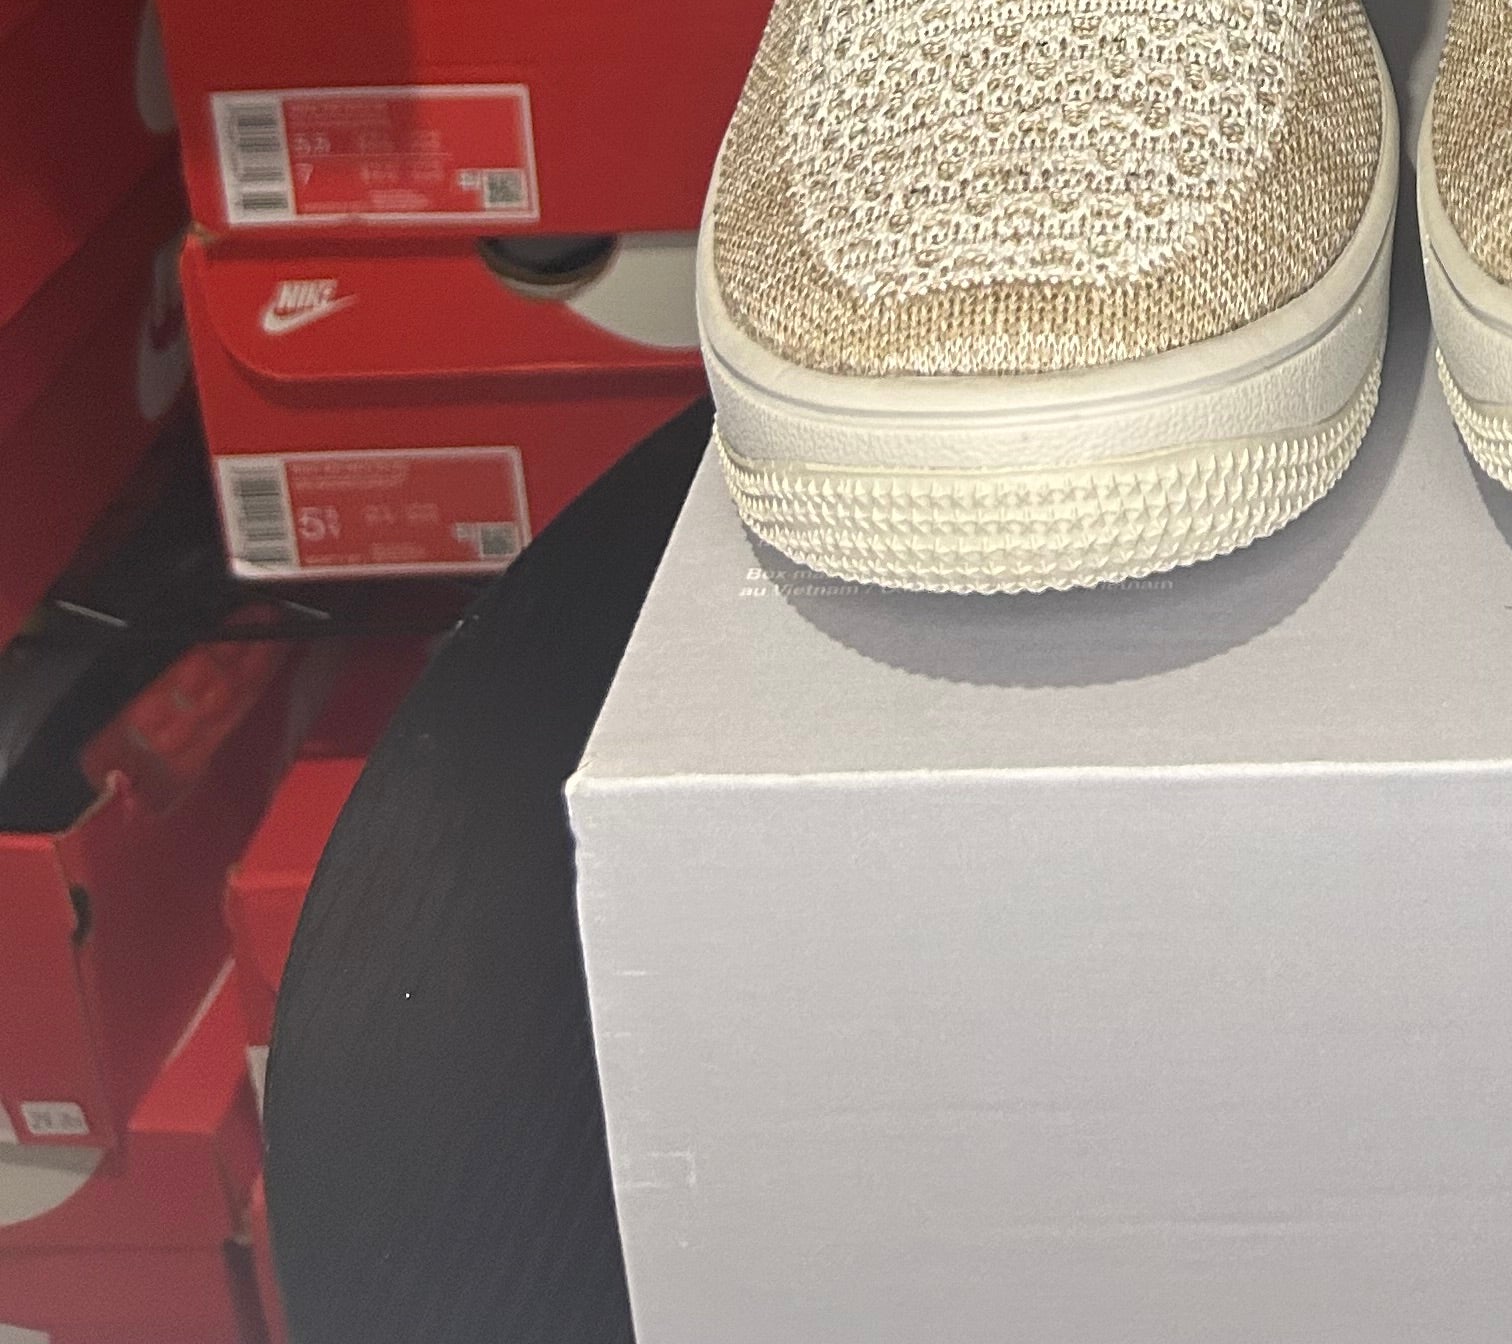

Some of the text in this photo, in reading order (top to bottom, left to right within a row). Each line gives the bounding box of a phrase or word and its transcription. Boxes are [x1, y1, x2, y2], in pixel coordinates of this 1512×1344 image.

[275, 278, 339, 313] NIKE
[746, 567, 787, 581] Box
[738, 586, 768, 598] au
[773, 583, 860, 597] Vietnam
